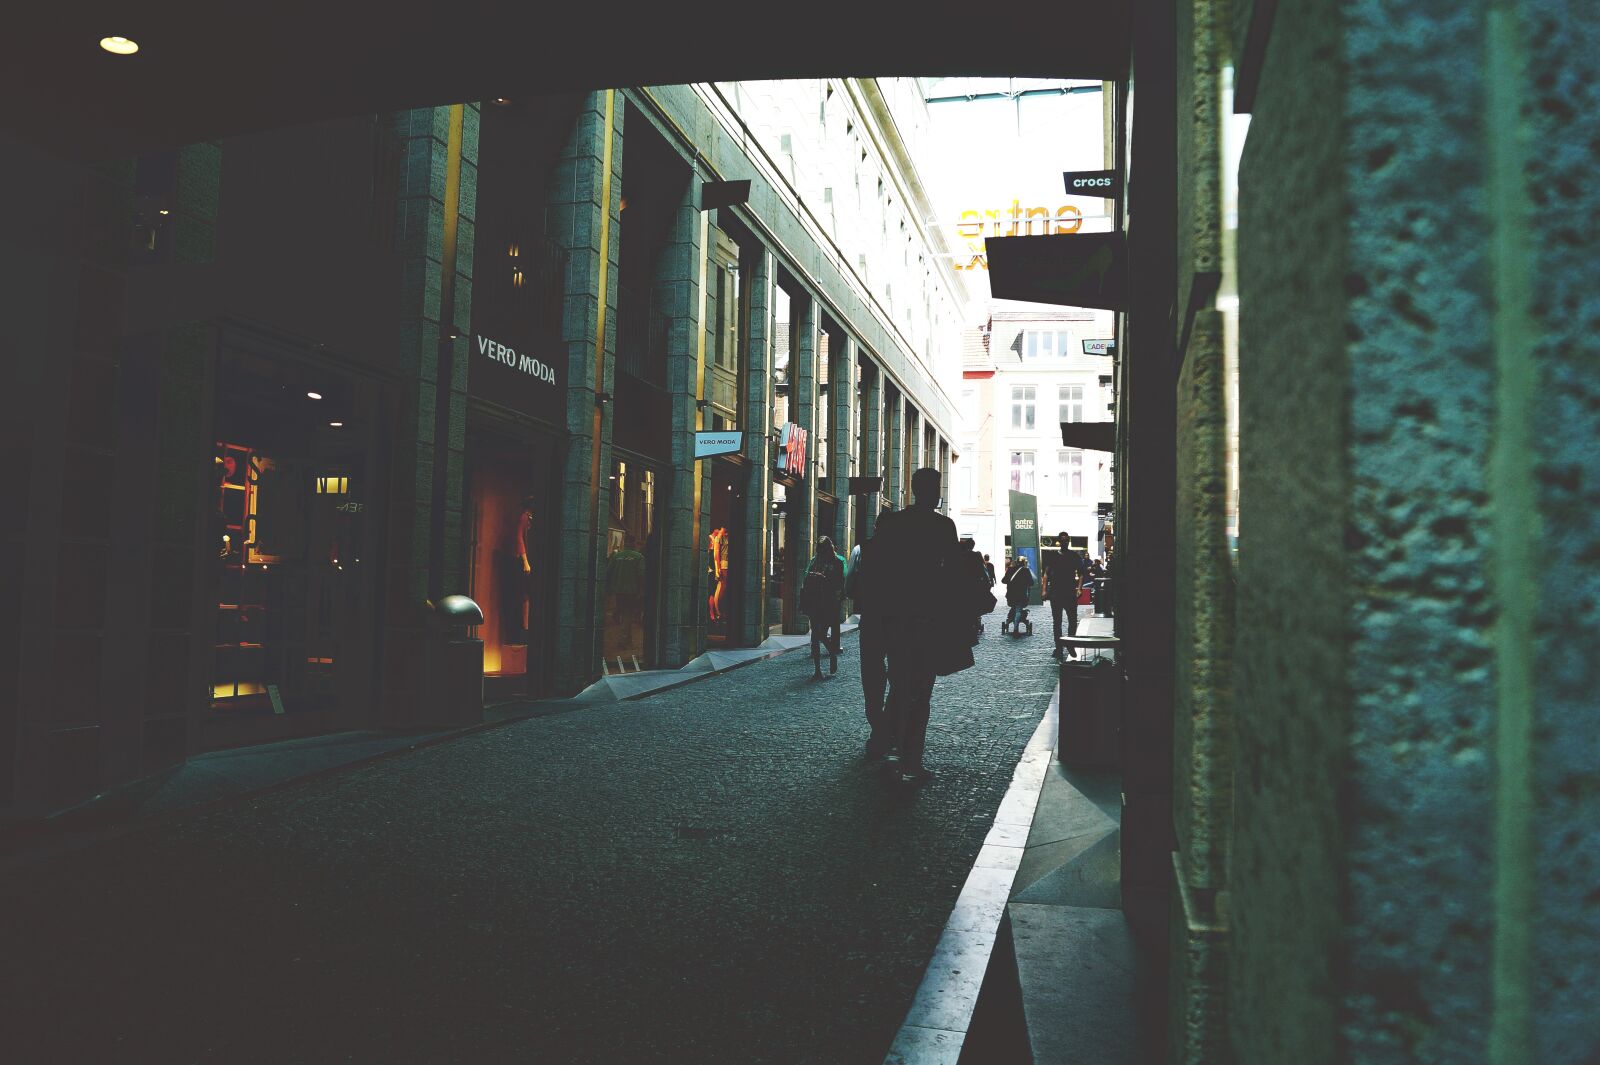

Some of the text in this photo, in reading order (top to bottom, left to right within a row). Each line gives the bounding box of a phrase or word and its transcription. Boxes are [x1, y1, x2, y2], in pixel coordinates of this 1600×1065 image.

[1073, 178, 1111, 187] crocs
[477, 334, 555, 386] VERO MODA
